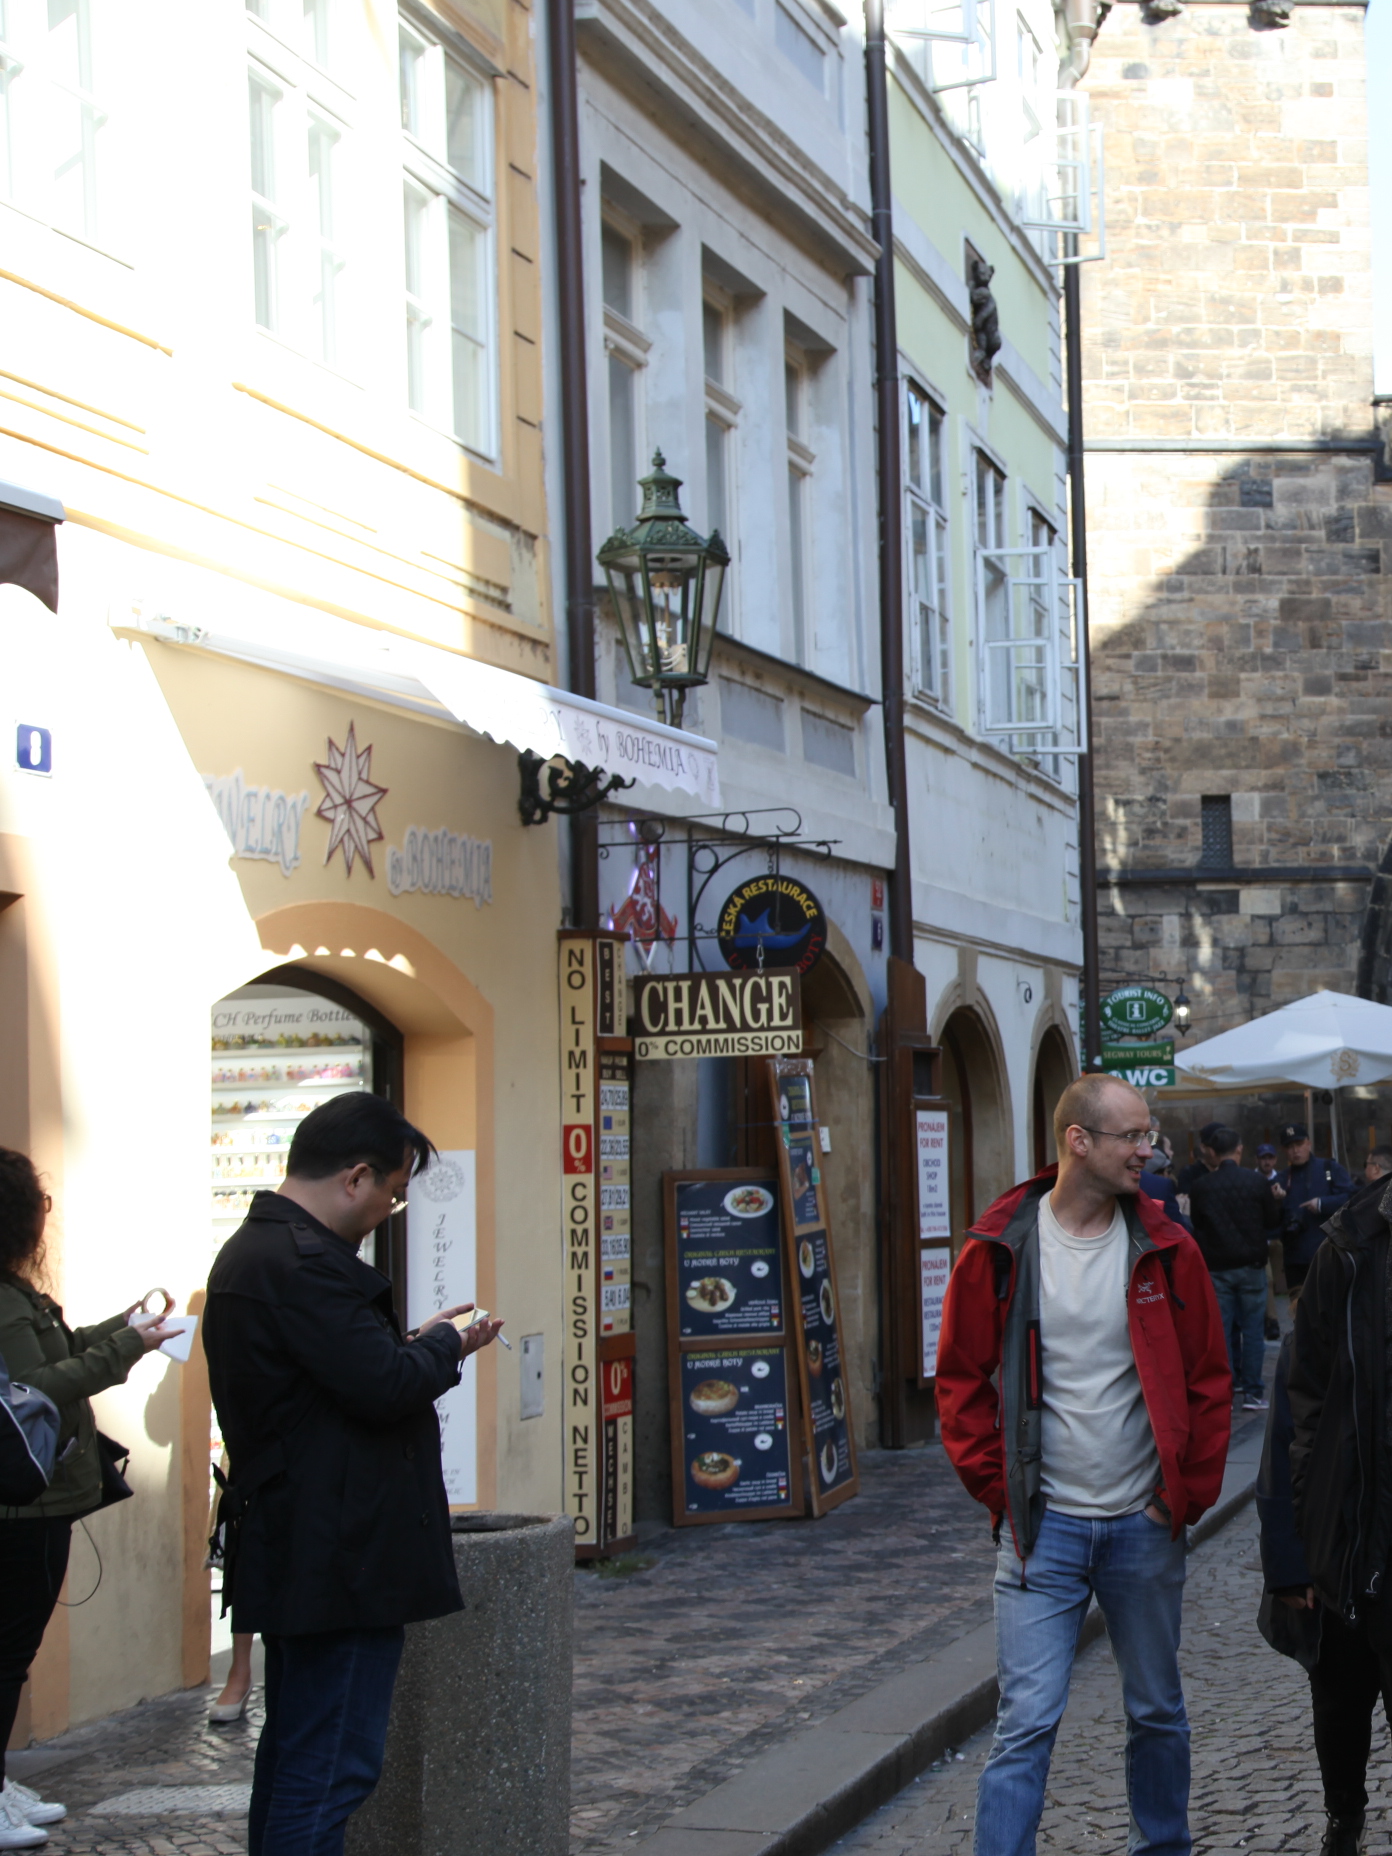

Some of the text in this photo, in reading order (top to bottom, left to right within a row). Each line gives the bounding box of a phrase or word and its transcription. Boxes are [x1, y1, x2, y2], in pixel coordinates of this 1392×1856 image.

[595, 720, 610, 763] by
[615, 731, 687, 776] BOHEMIA
[405, 829, 492, 902] BOHEMIA
[719, 879, 818, 940] ČESKÁ RESTAURACE
[603, 947, 611, 1025] BEST
[640, 975, 794, 1034] CHANGE
[1106, 988, 1165, 1006] TOURIST INFO
[212, 1010, 241, 1029] CH
[242, 1008, 304, 1030] Perfume
[1152, 1020, 1165, 1032] JAZZ
[567, 948, 588, 1114] NO LIMIT
[664, 1034, 801, 1057] COMMISSION
[1103, 1050, 1162, 1059] SEGWAY TOURS
[1125, 1069, 1168, 1087] WC
[918, 1119, 945, 1133] PRONÁJEM
[920, 1138, 943, 1148] FOR RENT
[926, 1171, 937, 1181] SHOP
[432, 1212, 454, 1310] JEWELRY
[719, 1256, 740, 1267] BOTY
[921, 1257, 948, 1271] PRONÁJEM
[923, 1275, 946, 1287] FOR RENT
[570, 1181, 590, 1408] COMMISSION
[722, 1357, 743, 1368] BOTY
[604, 1399, 632, 1417] COMMISSION
[572, 1425, 590, 1536] NETTO
[607, 1424, 615, 1540] WECHSEL
